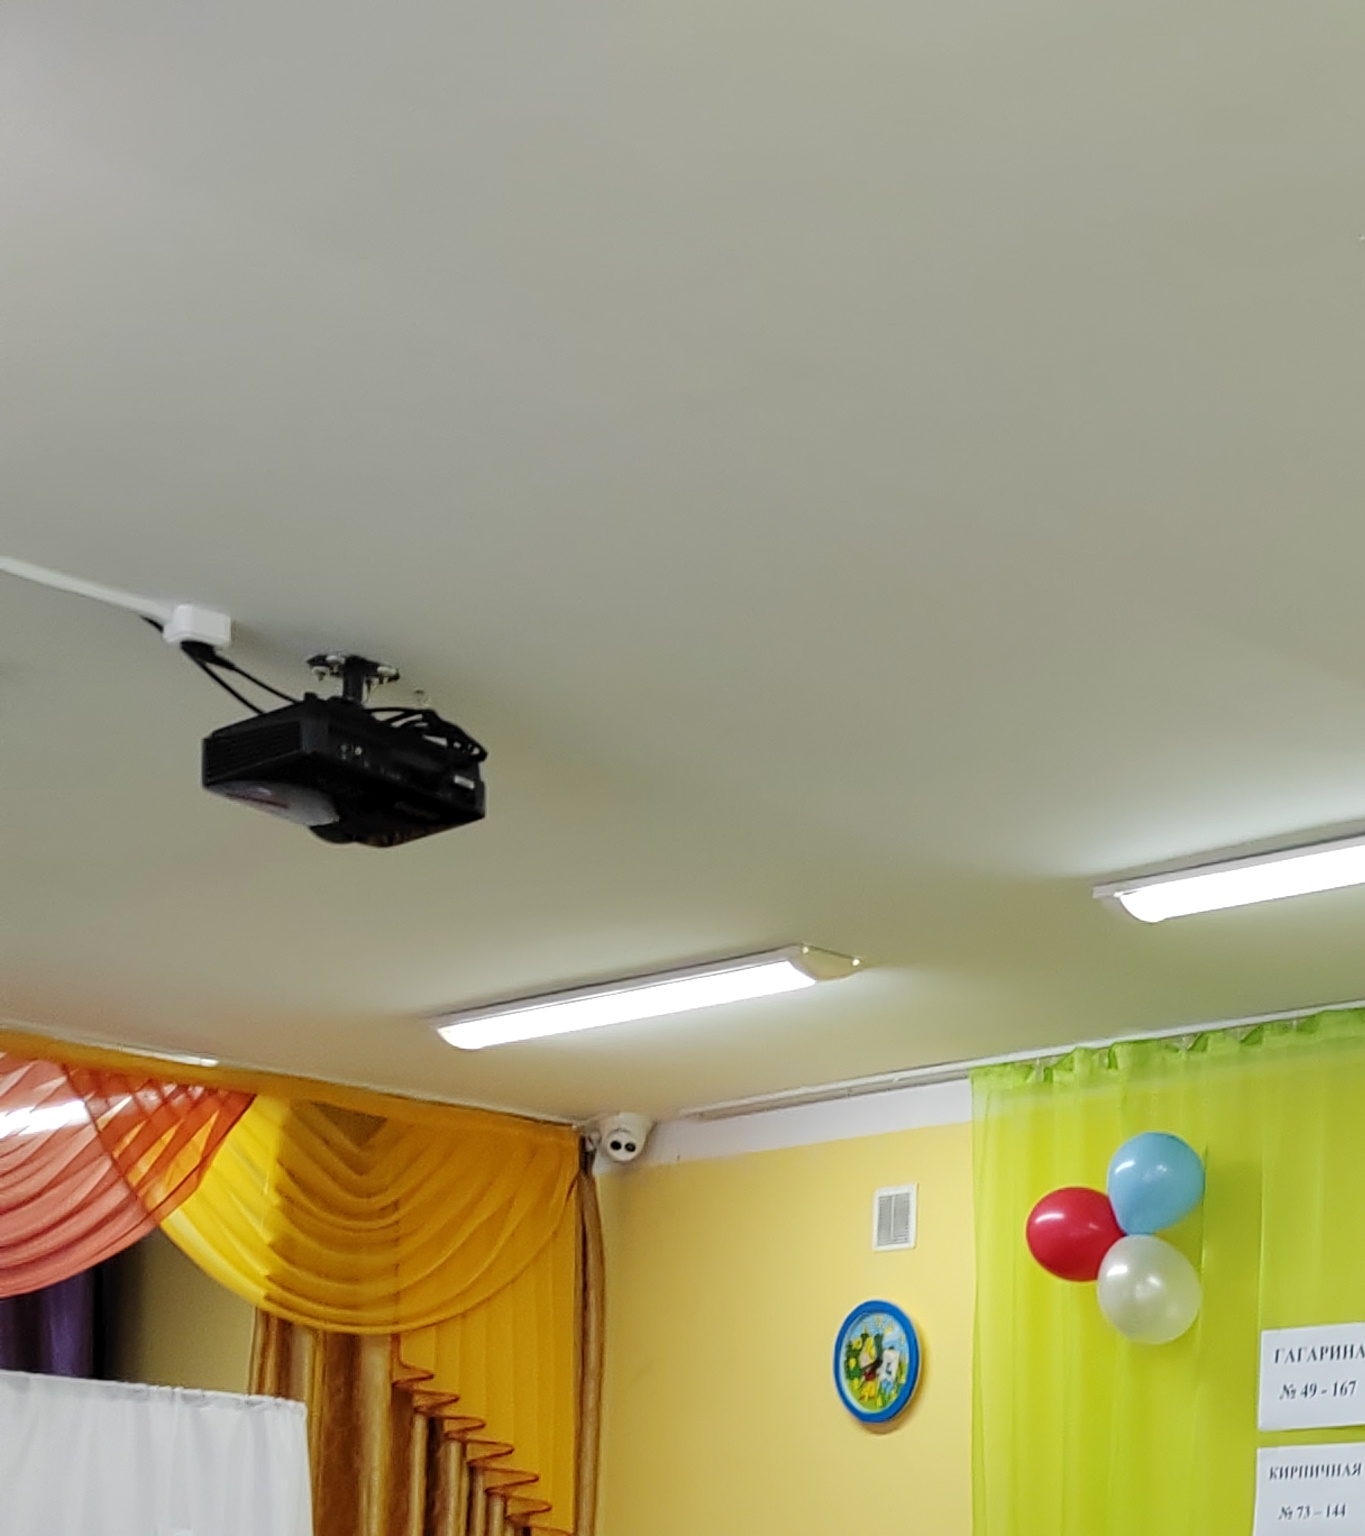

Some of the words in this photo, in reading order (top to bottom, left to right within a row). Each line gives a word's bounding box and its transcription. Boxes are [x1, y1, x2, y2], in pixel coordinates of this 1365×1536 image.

[1278, 1382, 1298, 1401] №
[1299, 1381, 1319, 1399] 49
[1330, 1378, 1358, 1398] 167
[1268, 1460, 1363, 1481] КИРПИЧНАЯ
[1277, 1504, 1295, 1521] №
[1295, 1504, 1312, 1521] 73
[1325, 1502, 1347, 1519] 144
